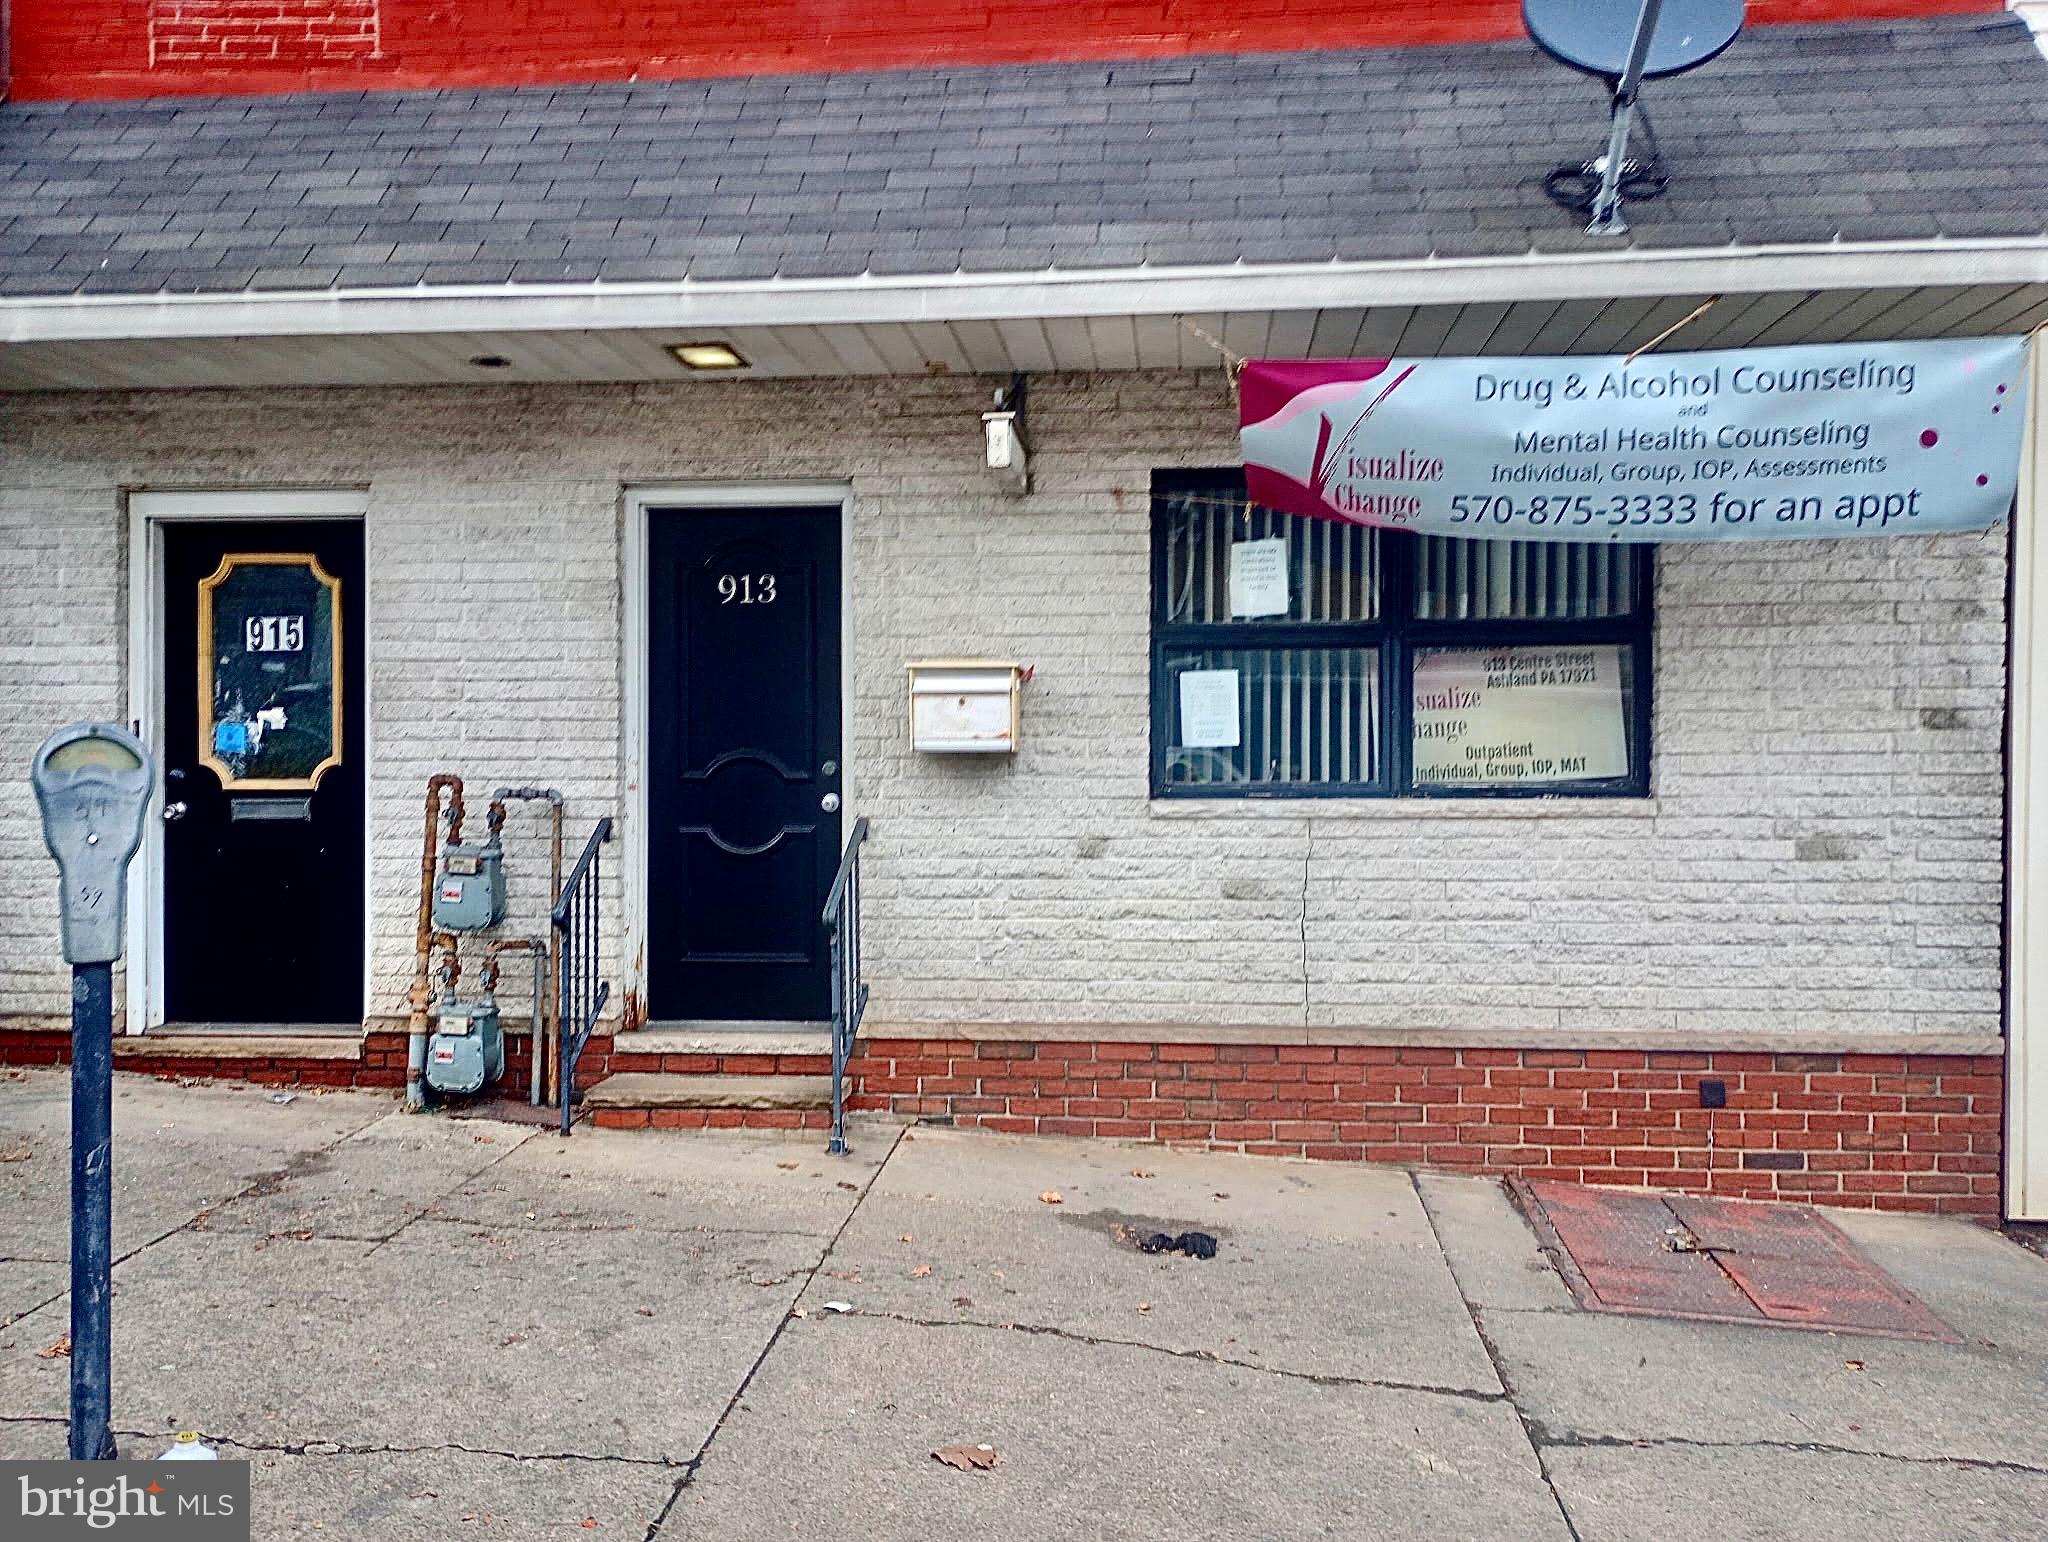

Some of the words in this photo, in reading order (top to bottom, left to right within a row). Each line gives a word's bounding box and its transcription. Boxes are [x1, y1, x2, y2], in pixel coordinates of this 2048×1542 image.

[1475, 373, 1553, 409] Drug
[1563, 372, 1588, 400] &
[1597, 366, 1720, 400] Alcohol
[1732, 359, 1917, 396] Counseling
[1678, 400, 1709, 417] and
[1514, 426, 1608, 453] Mental
[1617, 424, 1707, 451] Health
[1716, 419, 1871, 450] Counseling
[1490, 461, 1604, 484] Individual,
[1610, 461, 1687, 485] Group,
[1692, 458, 1738, 481] IOP,
[1744, 455, 1888, 479] Assessments
[1334, 483, 1422, 524] Change
[1450, 493, 1697, 526] 570-875-3333
[1709, 489, 1767, 524] for
[1775, 495, 1822, 523] an
[1834, 487, 1923, 528] appt
[717, 573, 777, 605] 913
[250, 616, 300, 650] 915
[1509, 653, 1553, 671] Centre
[1555, 651, 1596, 669] Street
[1487, 671, 1538, 690] Ashland
[1541, 668, 1557, 686] PA
[1415, 686, 1481, 711] sualize
[1465, 741, 1534, 761] Outpatient
[1416, 763, 1482, 781] Individual,
[1485, 761, 1528, 777] Group,
[1532, 758, 1557, 776] IOP,
[1561, 756, 1587, 773] MAT
